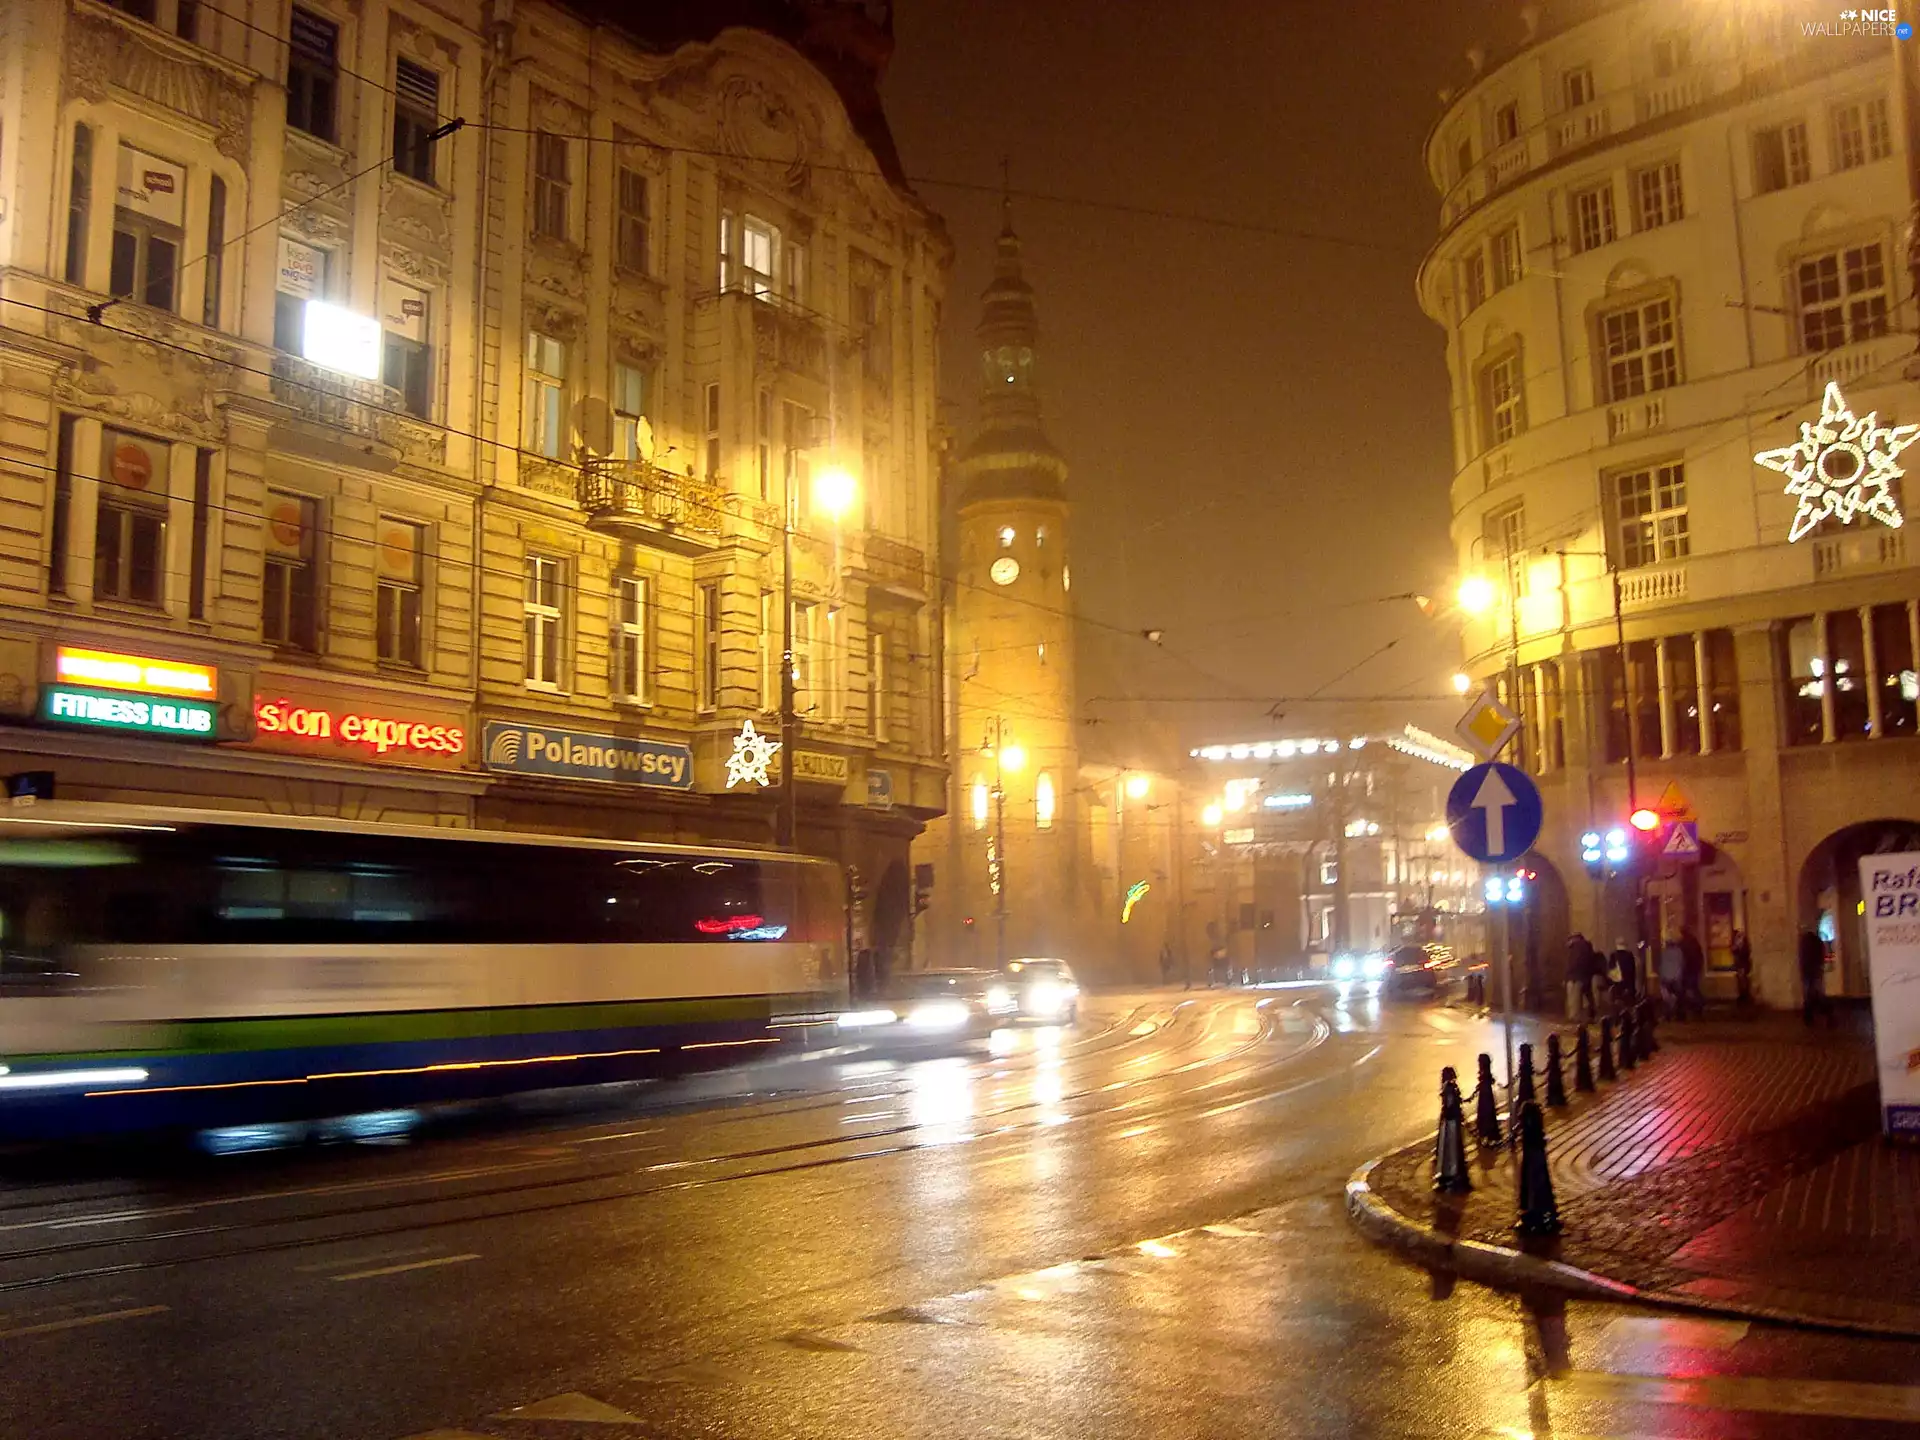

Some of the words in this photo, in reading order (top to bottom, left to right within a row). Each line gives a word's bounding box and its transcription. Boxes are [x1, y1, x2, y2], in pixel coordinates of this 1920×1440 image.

[52, 692, 149, 725] FITNESS
[152, 704, 212, 732] KLUB
[340, 714, 464, 753] express
[526, 732, 686, 783] Polanowscy
